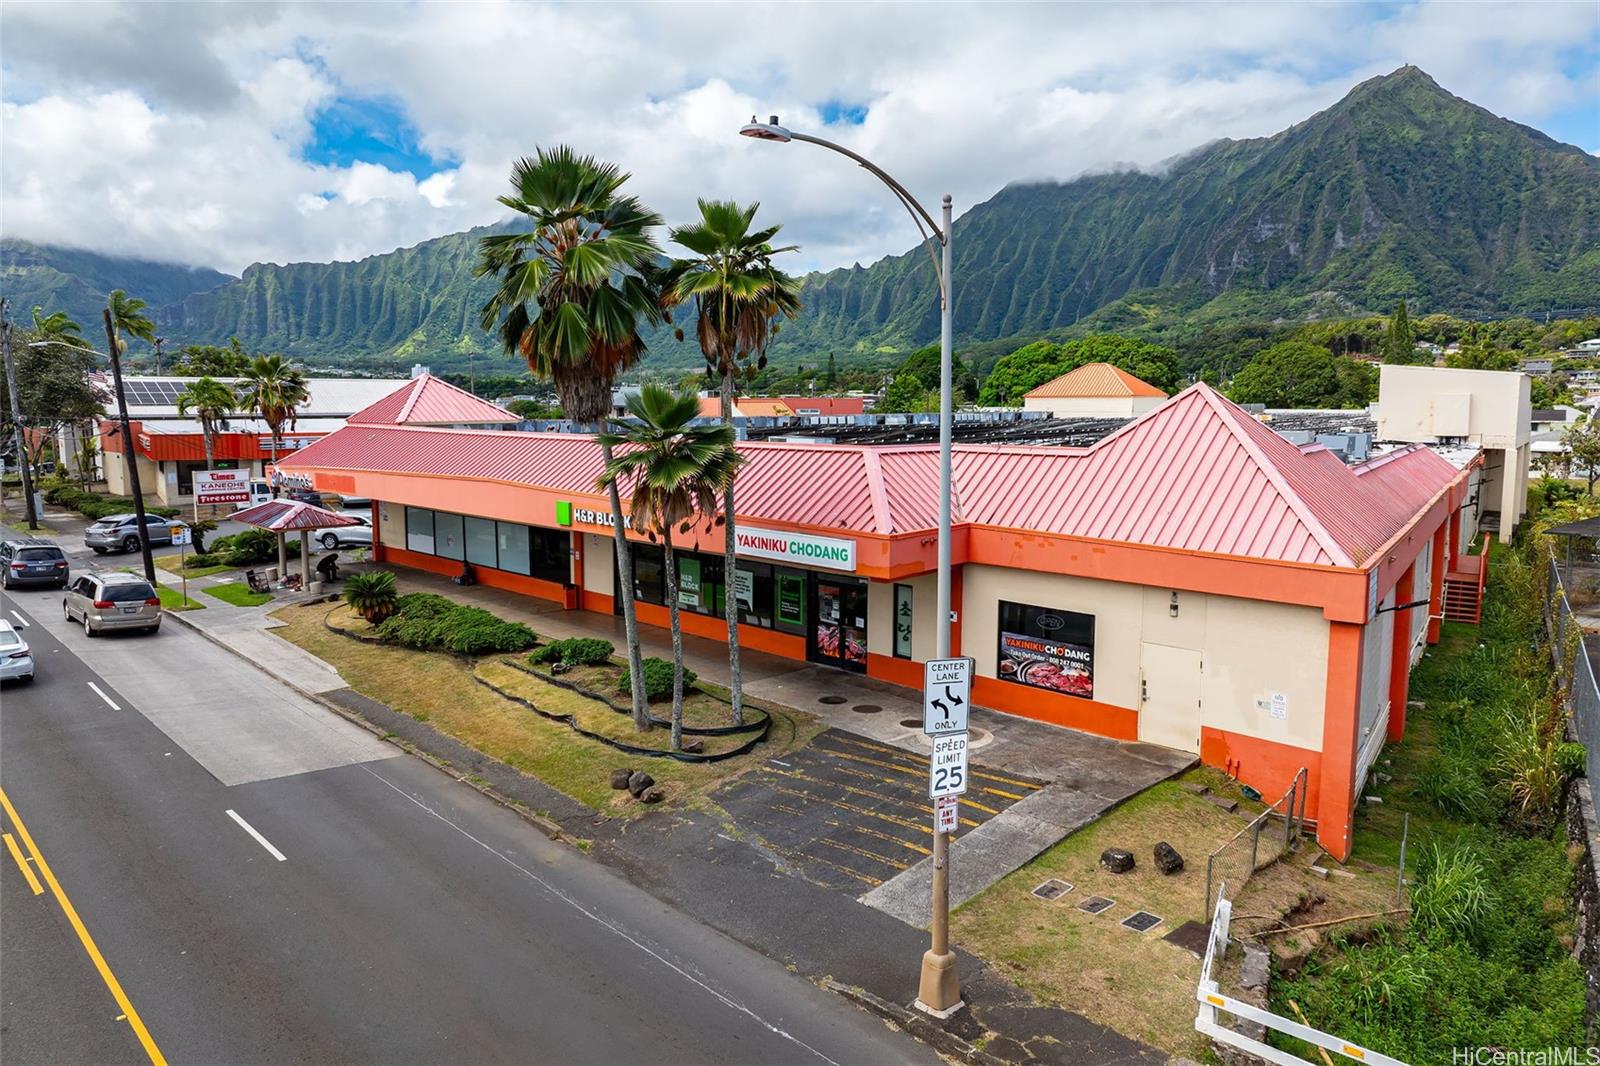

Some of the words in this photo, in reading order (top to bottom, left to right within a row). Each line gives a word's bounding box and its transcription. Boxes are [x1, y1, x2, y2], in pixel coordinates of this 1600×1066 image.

[201, 481, 245, 489] KANEOHE
[199, 494, 247, 503] Firestone
[574, 508, 594, 524] H&R
[596, 511, 631, 529] BLOK
[737, 534, 787, 553] YAKINIKU
[789, 541, 849, 562] CHODANG
[1022, 651, 1031, 659] Out
[1031, 652, 1045, 661] Order
[931, 663, 965, 672] CENTER
[936, 672, 960, 681] LANE
[934, 720, 958, 730] ONLY
[935, 740, 966, 753] SPEED
[937, 753, 961, 765] LIMIT
[934, 766, 963, 791] 25
[942, 809, 953, 818] ANY
[941, 817, 954, 826] TIME
